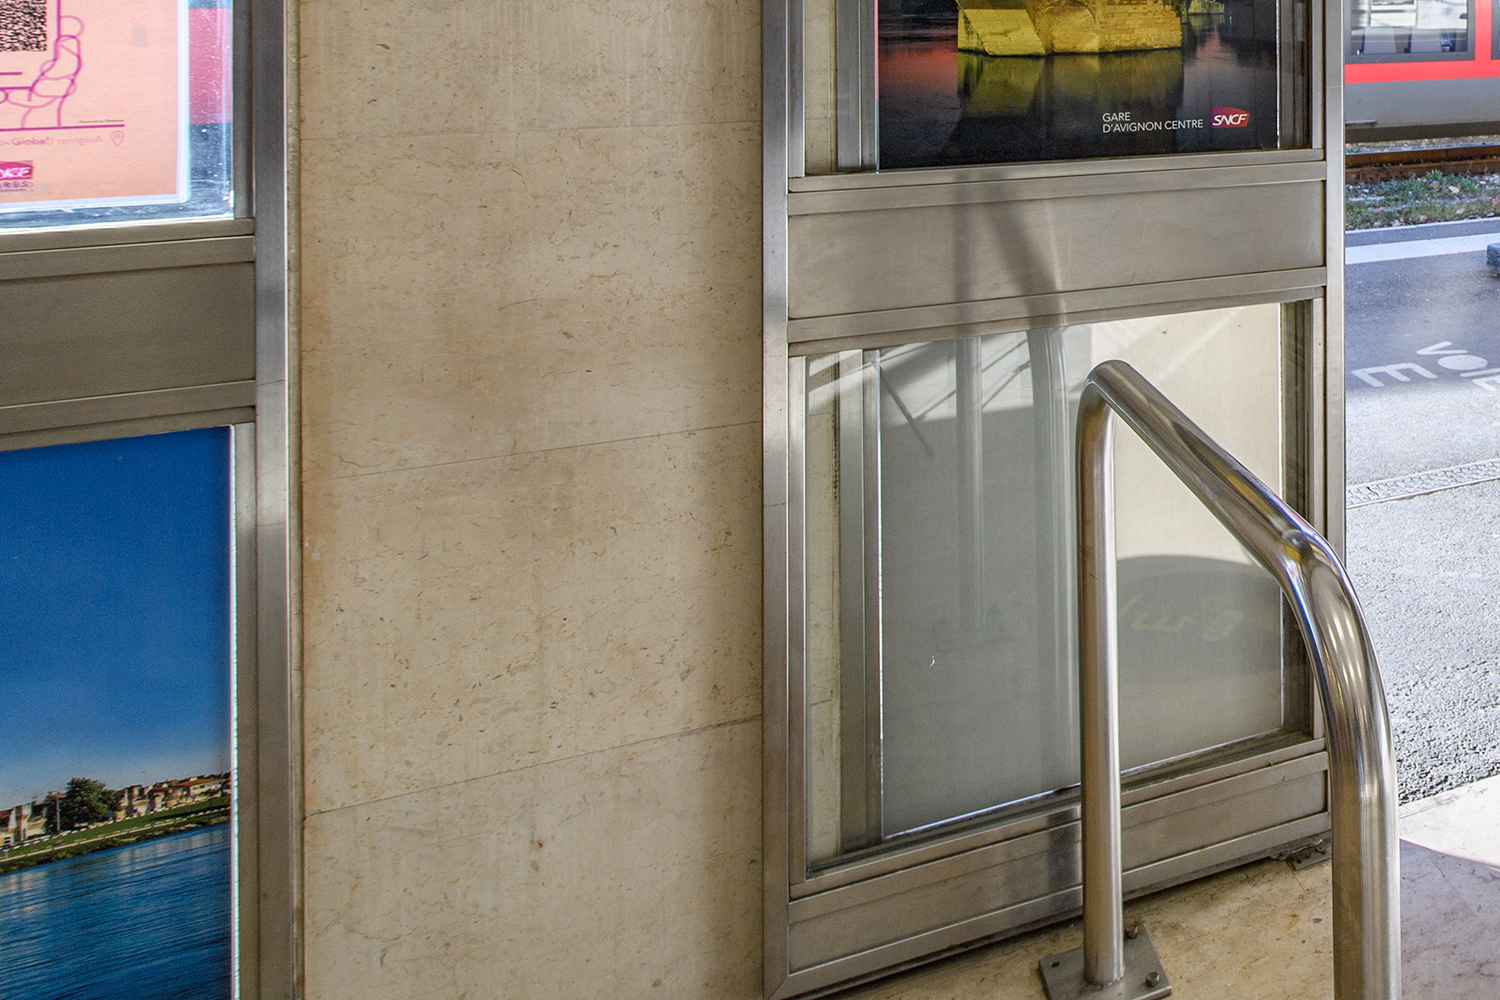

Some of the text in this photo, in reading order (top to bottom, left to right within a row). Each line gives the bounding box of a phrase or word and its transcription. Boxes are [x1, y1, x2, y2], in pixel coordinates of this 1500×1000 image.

[1102, 110, 1131, 122] GARE
[1212, 113, 1248, 128] SNCF
[1164, 117, 1204, 131] CENTRE
